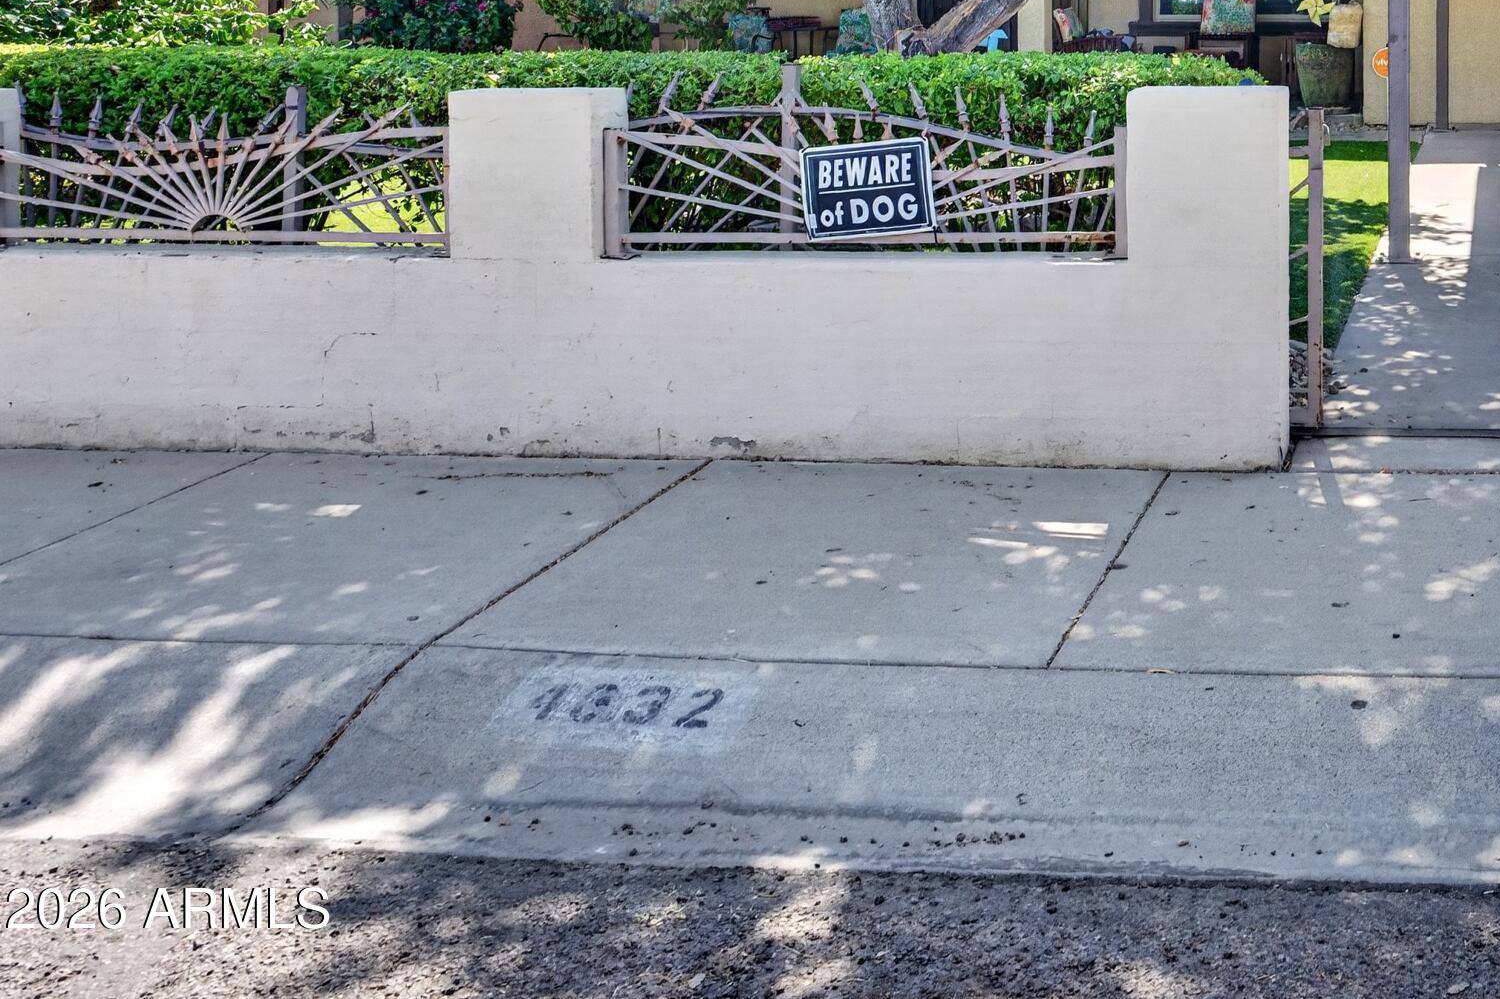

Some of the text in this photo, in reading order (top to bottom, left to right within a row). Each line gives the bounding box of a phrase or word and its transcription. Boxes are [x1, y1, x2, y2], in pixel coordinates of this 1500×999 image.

[818, 152, 912, 189] BEWARE
[820, 192, 919, 228] of DOG
